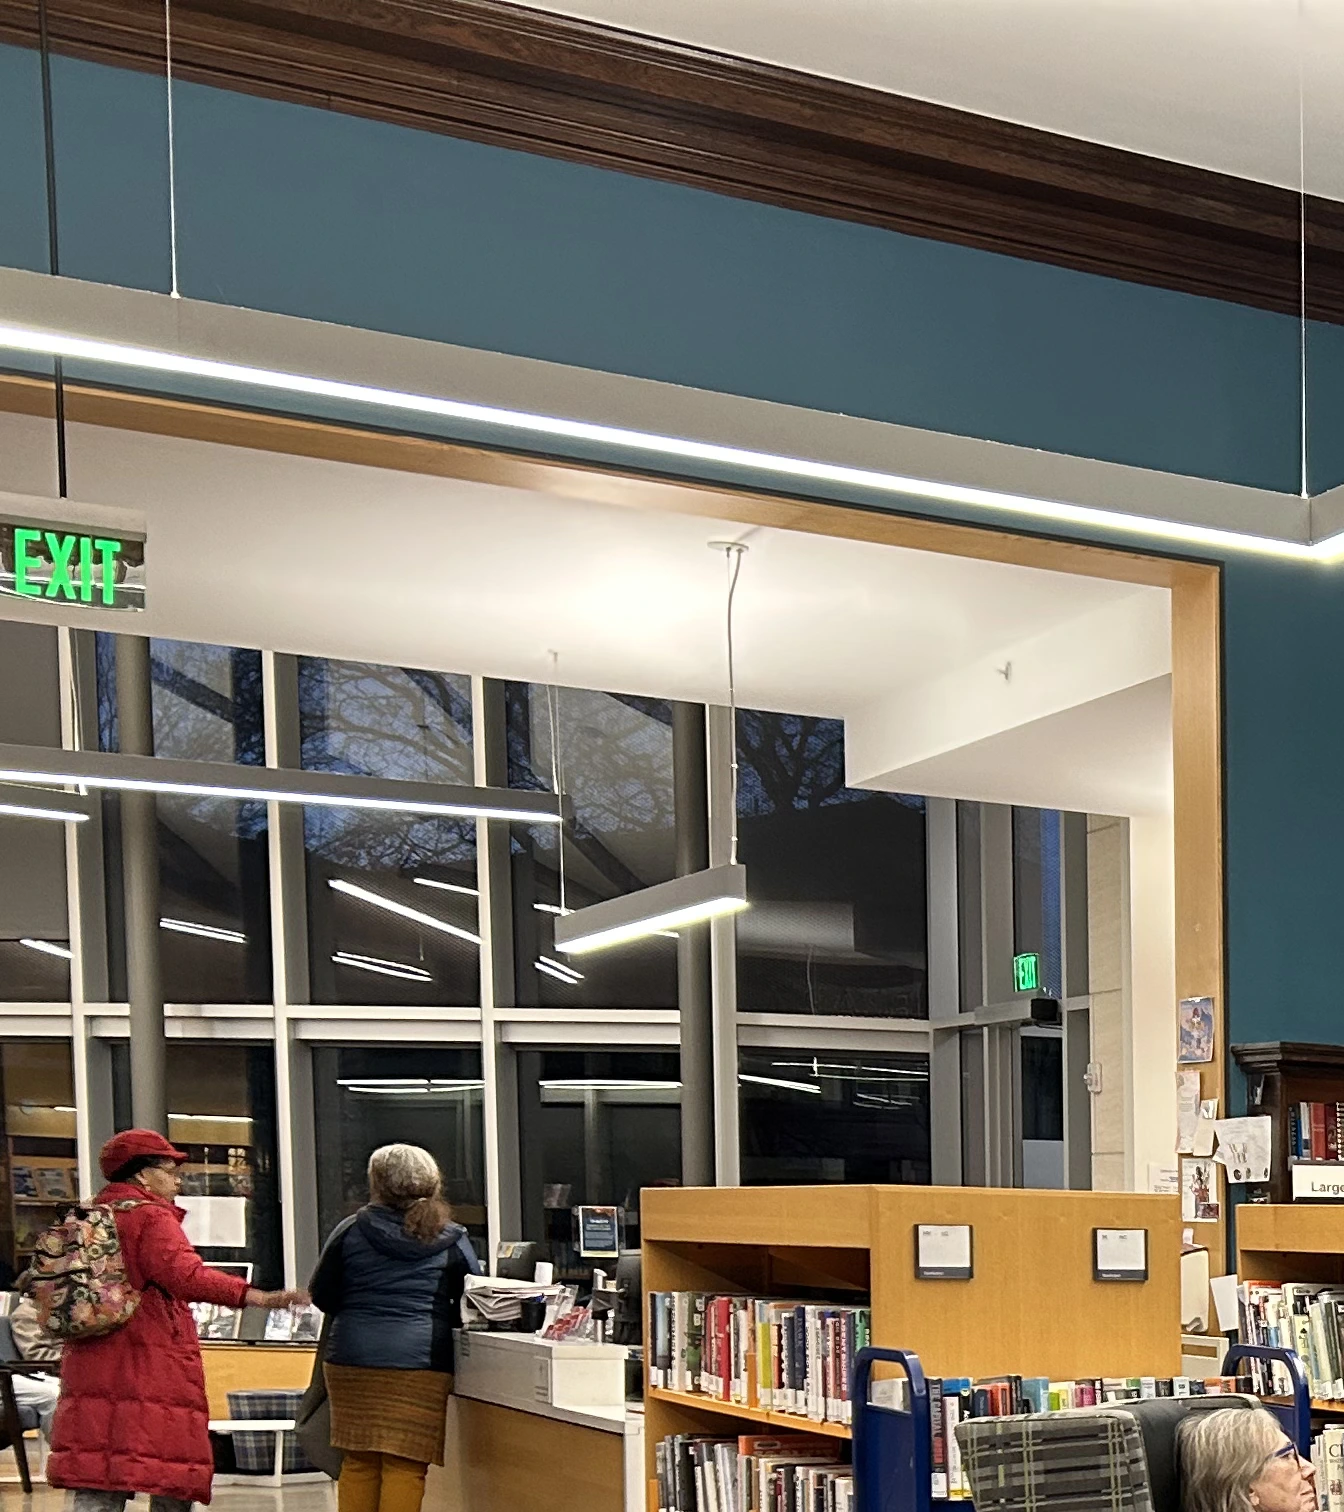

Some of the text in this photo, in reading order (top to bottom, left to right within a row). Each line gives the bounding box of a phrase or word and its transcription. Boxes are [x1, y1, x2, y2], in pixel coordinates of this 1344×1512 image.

[15, 528, 121, 605] EXIT
[931, 1383, 941, 1399] THE
[931, 1401, 942, 1435] CAPITAL
